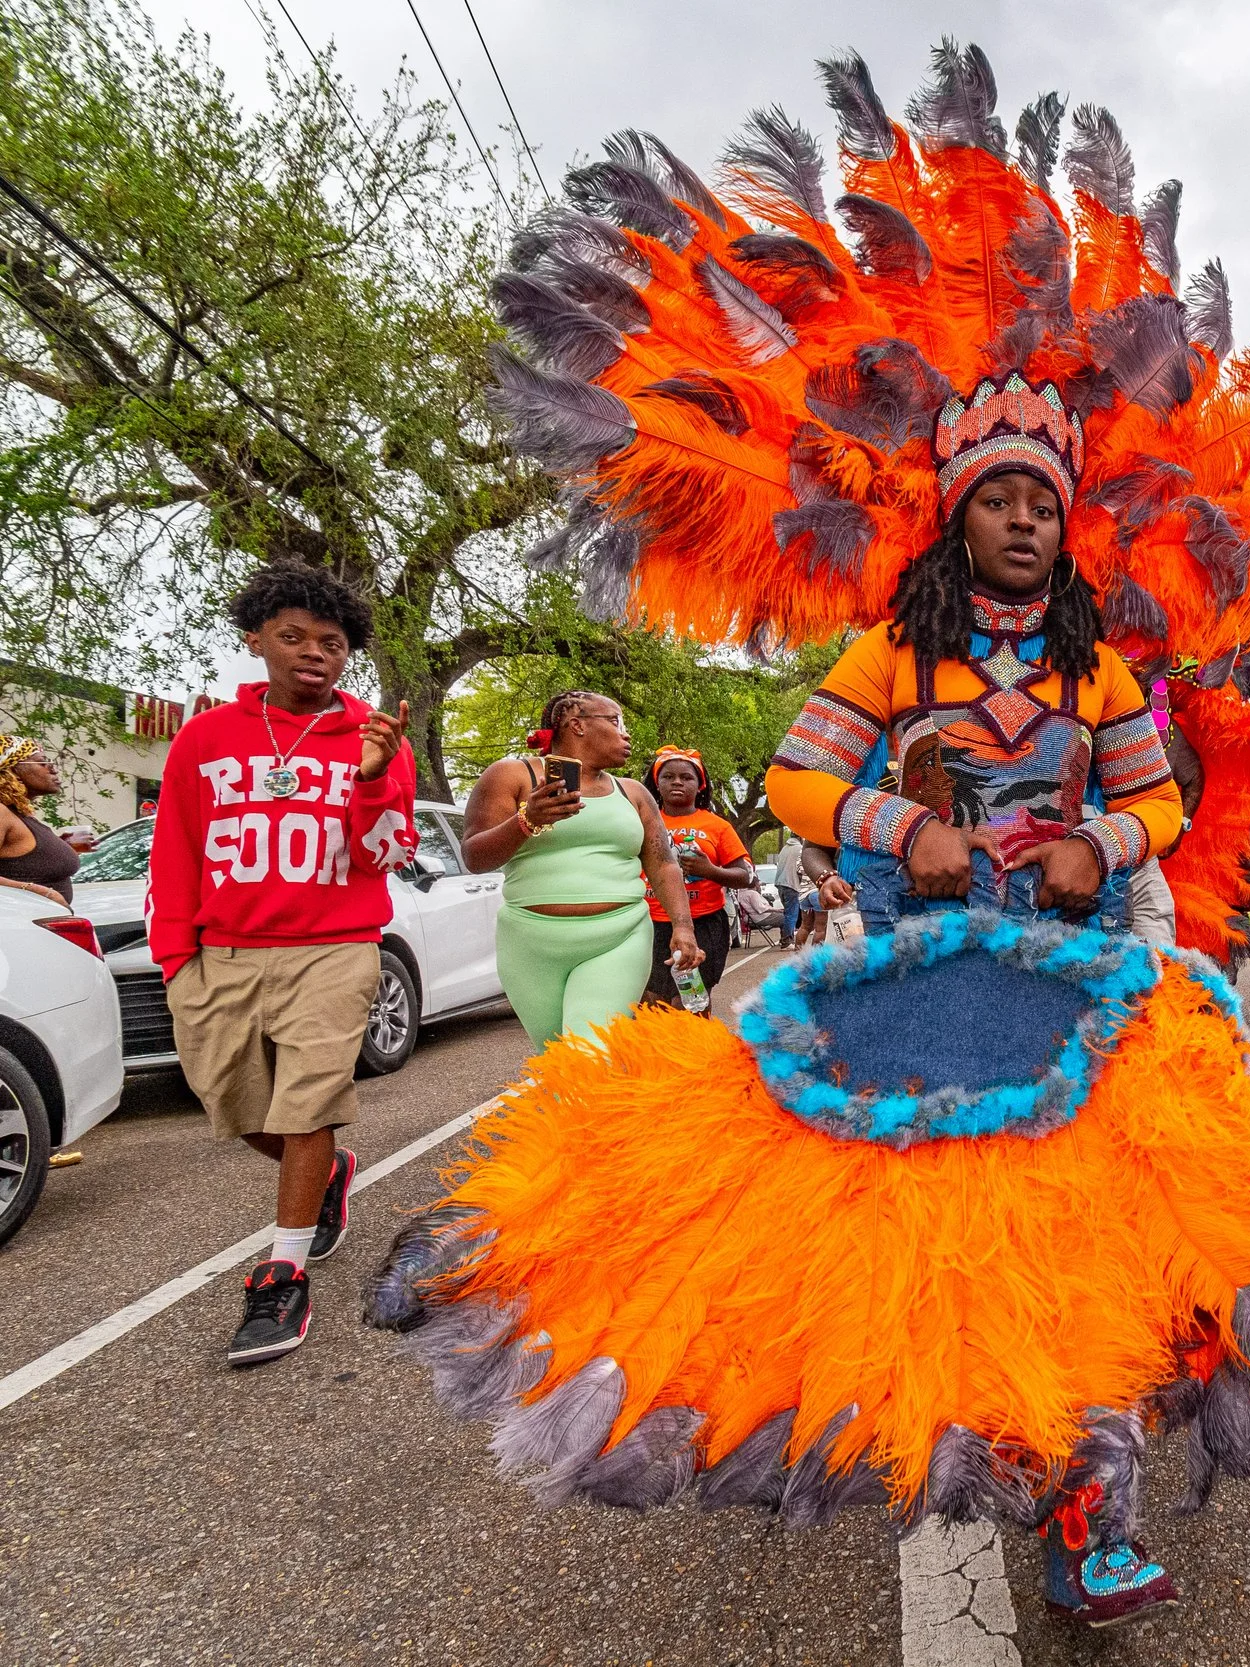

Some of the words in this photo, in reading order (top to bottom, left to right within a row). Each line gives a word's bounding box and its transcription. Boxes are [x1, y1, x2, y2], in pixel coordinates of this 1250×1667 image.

[199, 756, 359, 808] RICH
[205, 812, 349, 889] SOON
[666, 828, 707, 839] WARD
